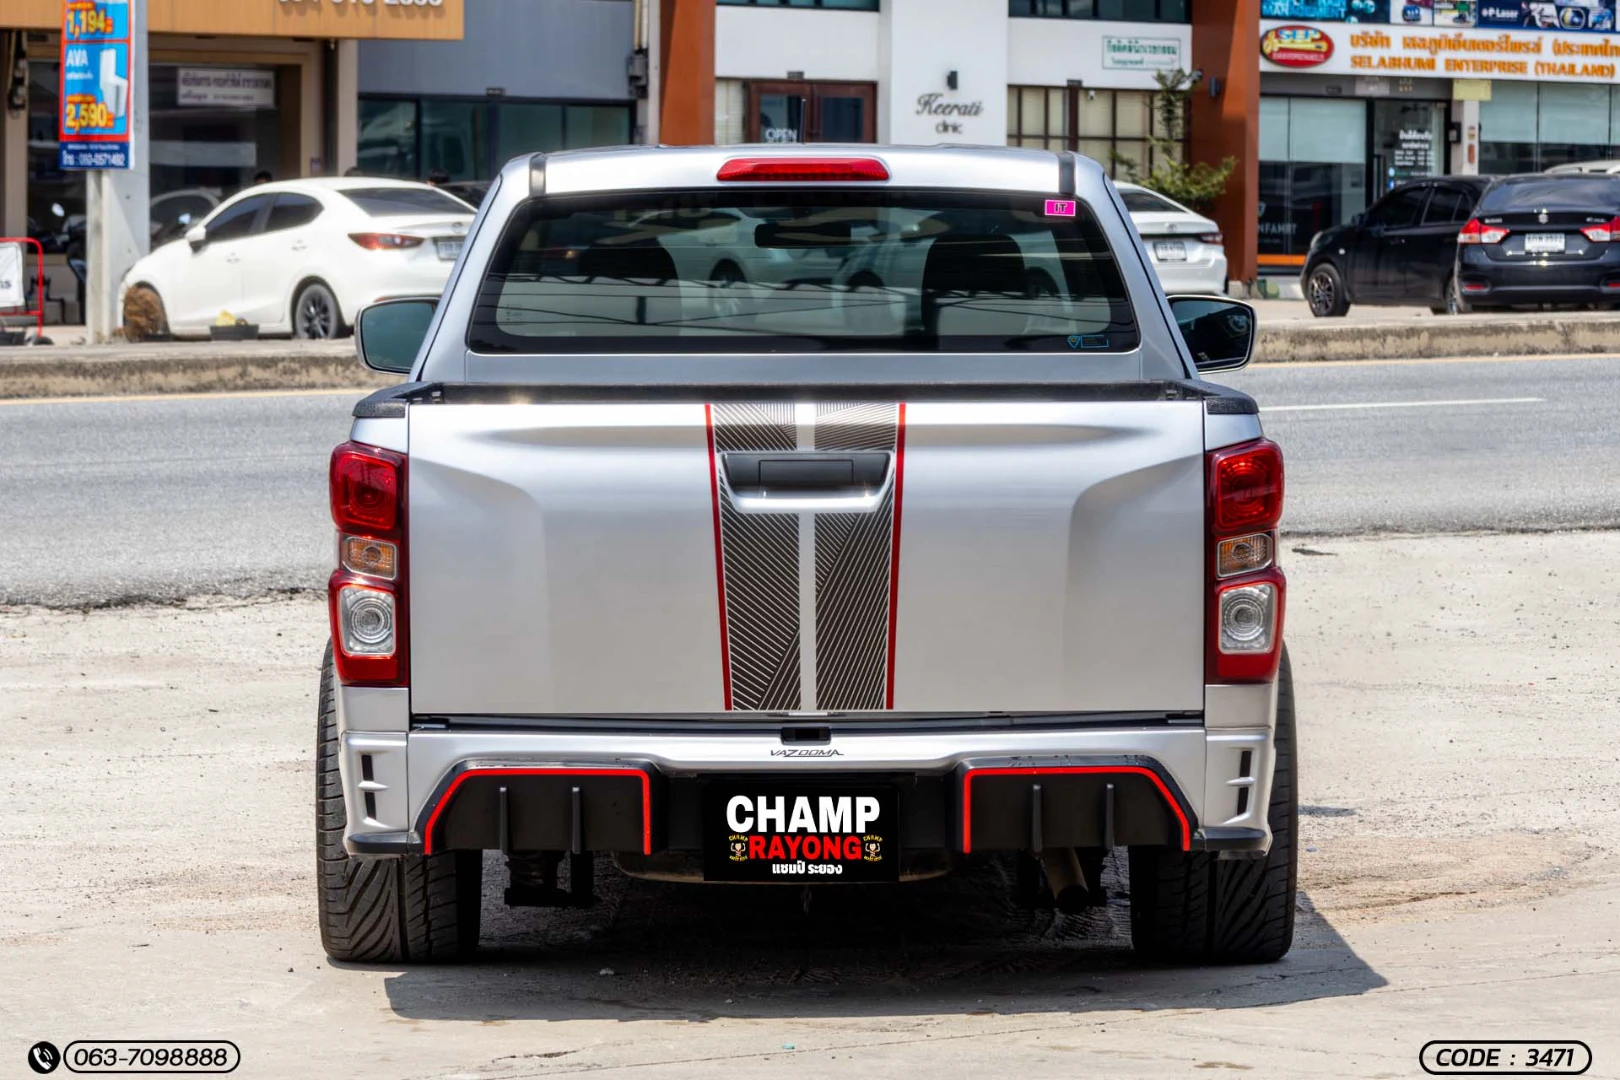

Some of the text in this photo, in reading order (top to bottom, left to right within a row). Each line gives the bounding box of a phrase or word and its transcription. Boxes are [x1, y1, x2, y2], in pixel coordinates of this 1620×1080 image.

[1444, 58, 1528, 75] ENTERPRISE
[1534, 60, 1616, 79] (THAILAND)
[915, 92, 984, 116] Keerati
[66, 103, 107, 132] 2,590
[765, 128, 798, 142] OPEN
[1054, 203, 1068, 214] IT
